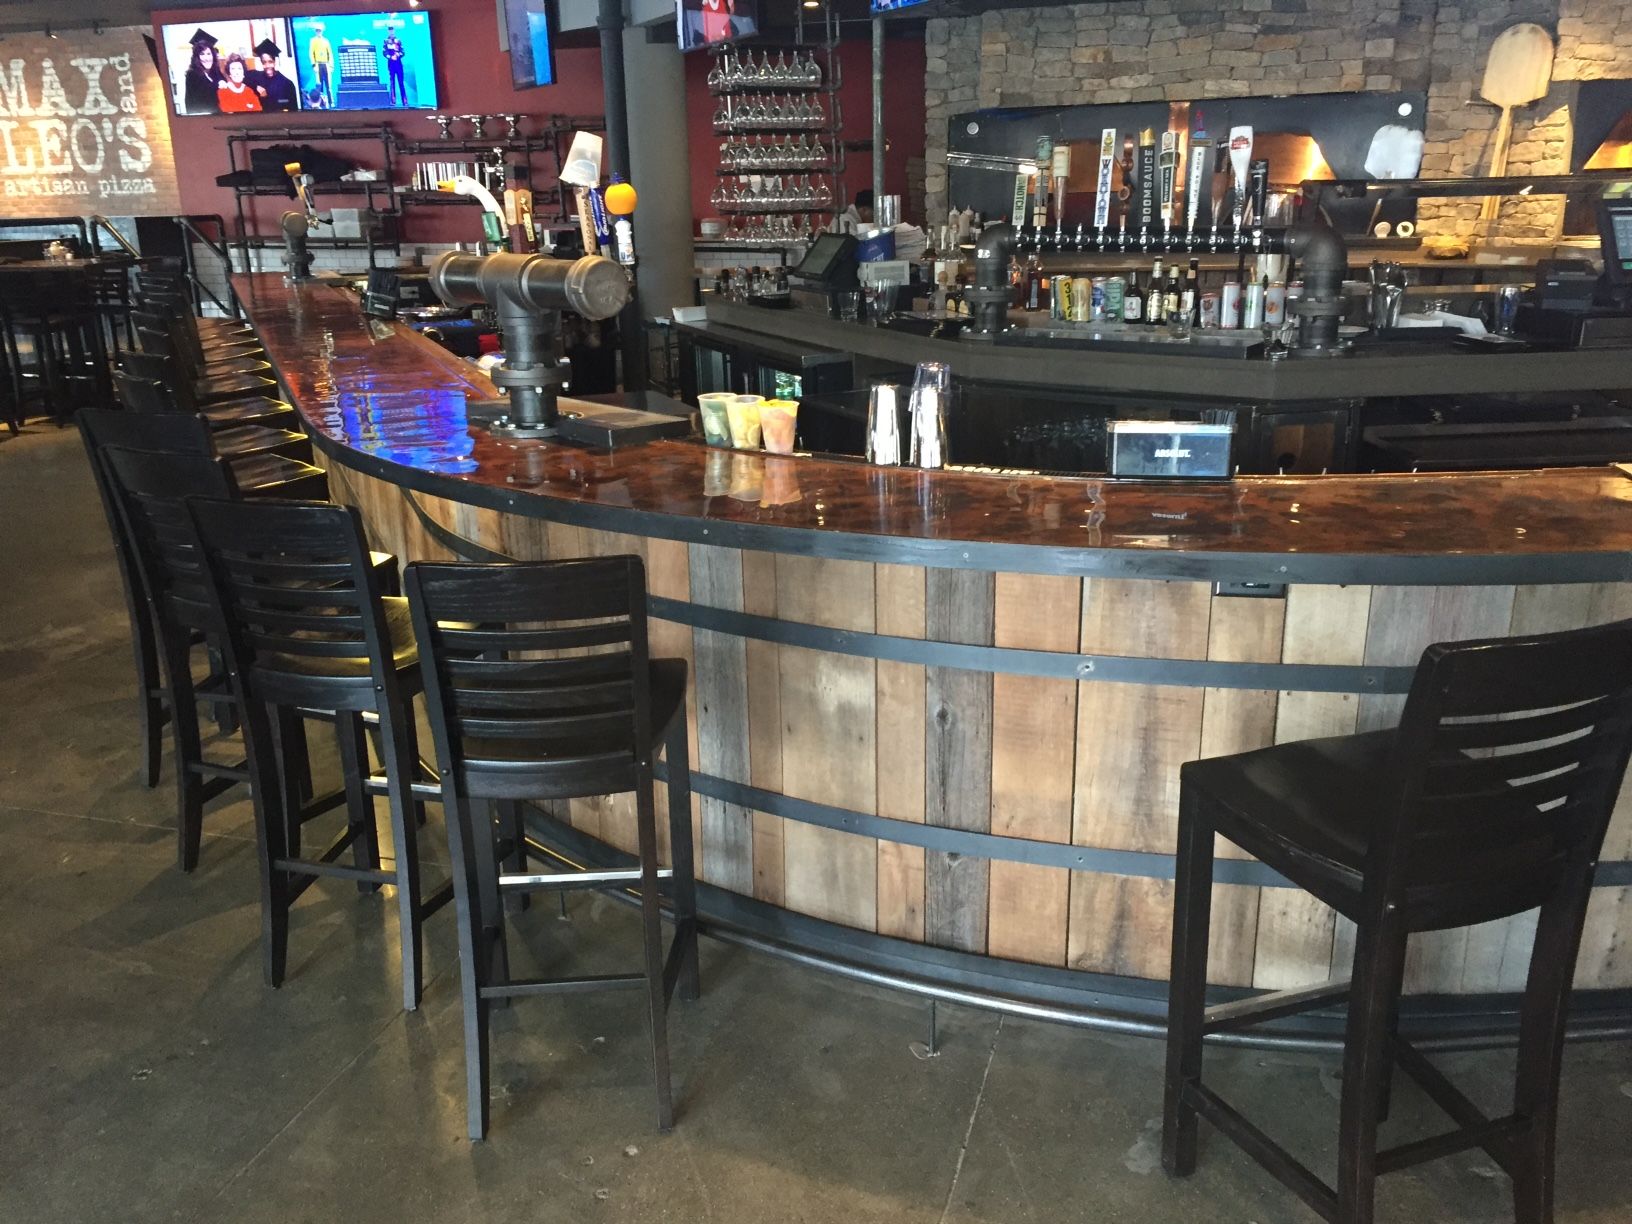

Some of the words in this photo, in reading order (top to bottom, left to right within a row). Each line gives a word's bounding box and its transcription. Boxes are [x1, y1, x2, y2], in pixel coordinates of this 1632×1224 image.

[0, 58, 118, 116] MAX
[109, 53, 138, 114] and
[0, 117, 152, 174] LEO'S
[4, 177, 90, 196] artisan
[98, 175, 157, 198] pizza
[1015, 185, 1026, 211] NOTCH
[1142, 149, 1154, 223] BOOMSAUCE
